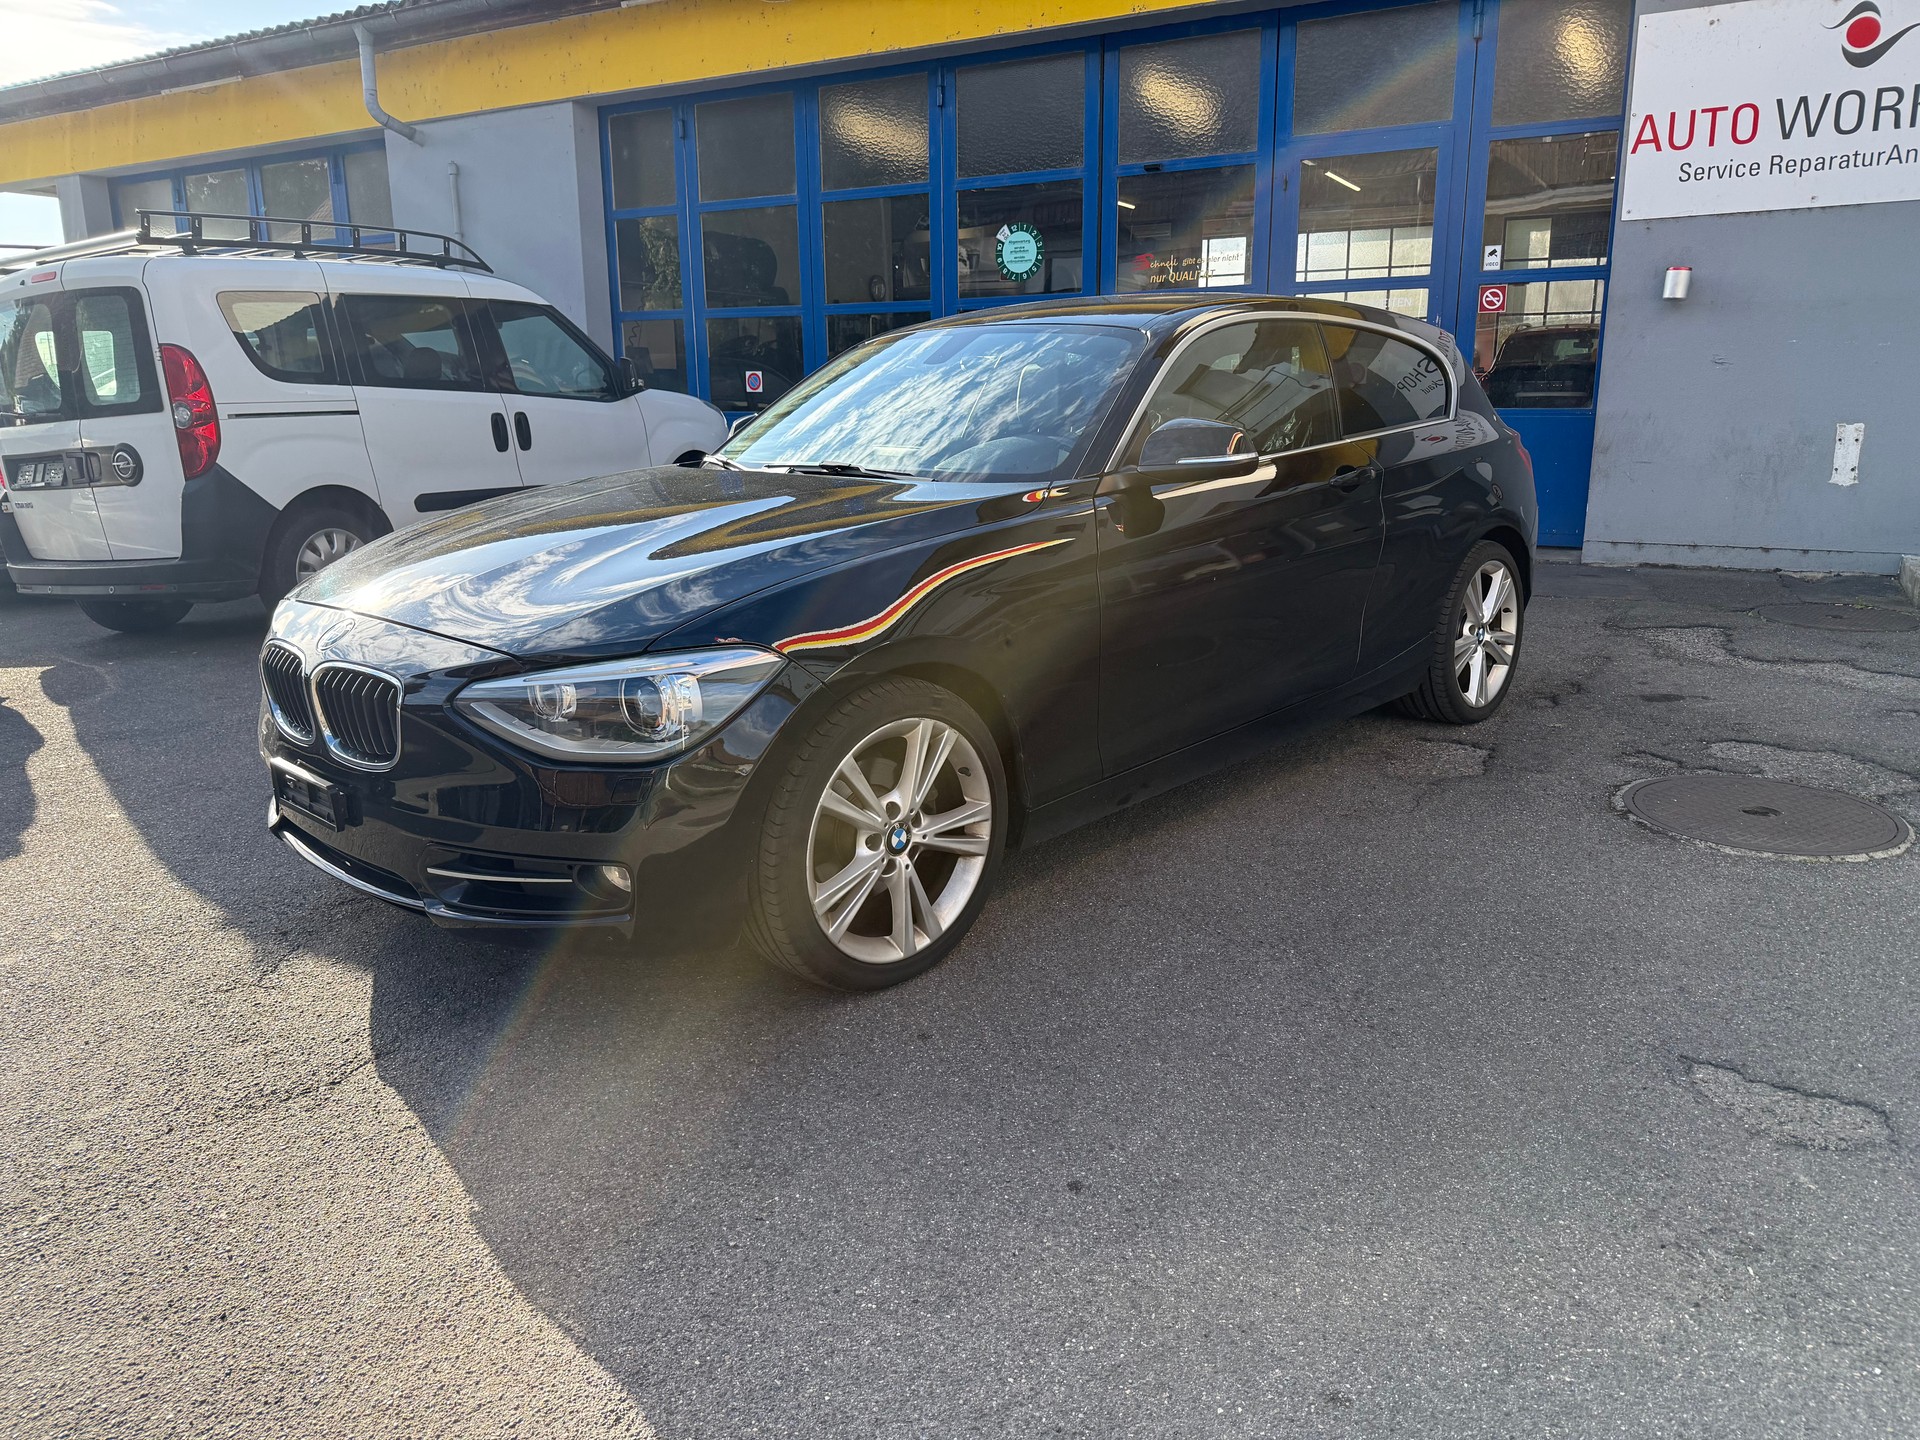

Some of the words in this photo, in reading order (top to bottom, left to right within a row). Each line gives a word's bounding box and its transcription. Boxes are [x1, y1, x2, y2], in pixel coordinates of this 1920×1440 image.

[1630, 103, 1760, 154] AUTO
[1678, 159, 1761, 183] Service
[1022, 272, 1027, 280] 6
[1149, 273, 1167, 284] nur
